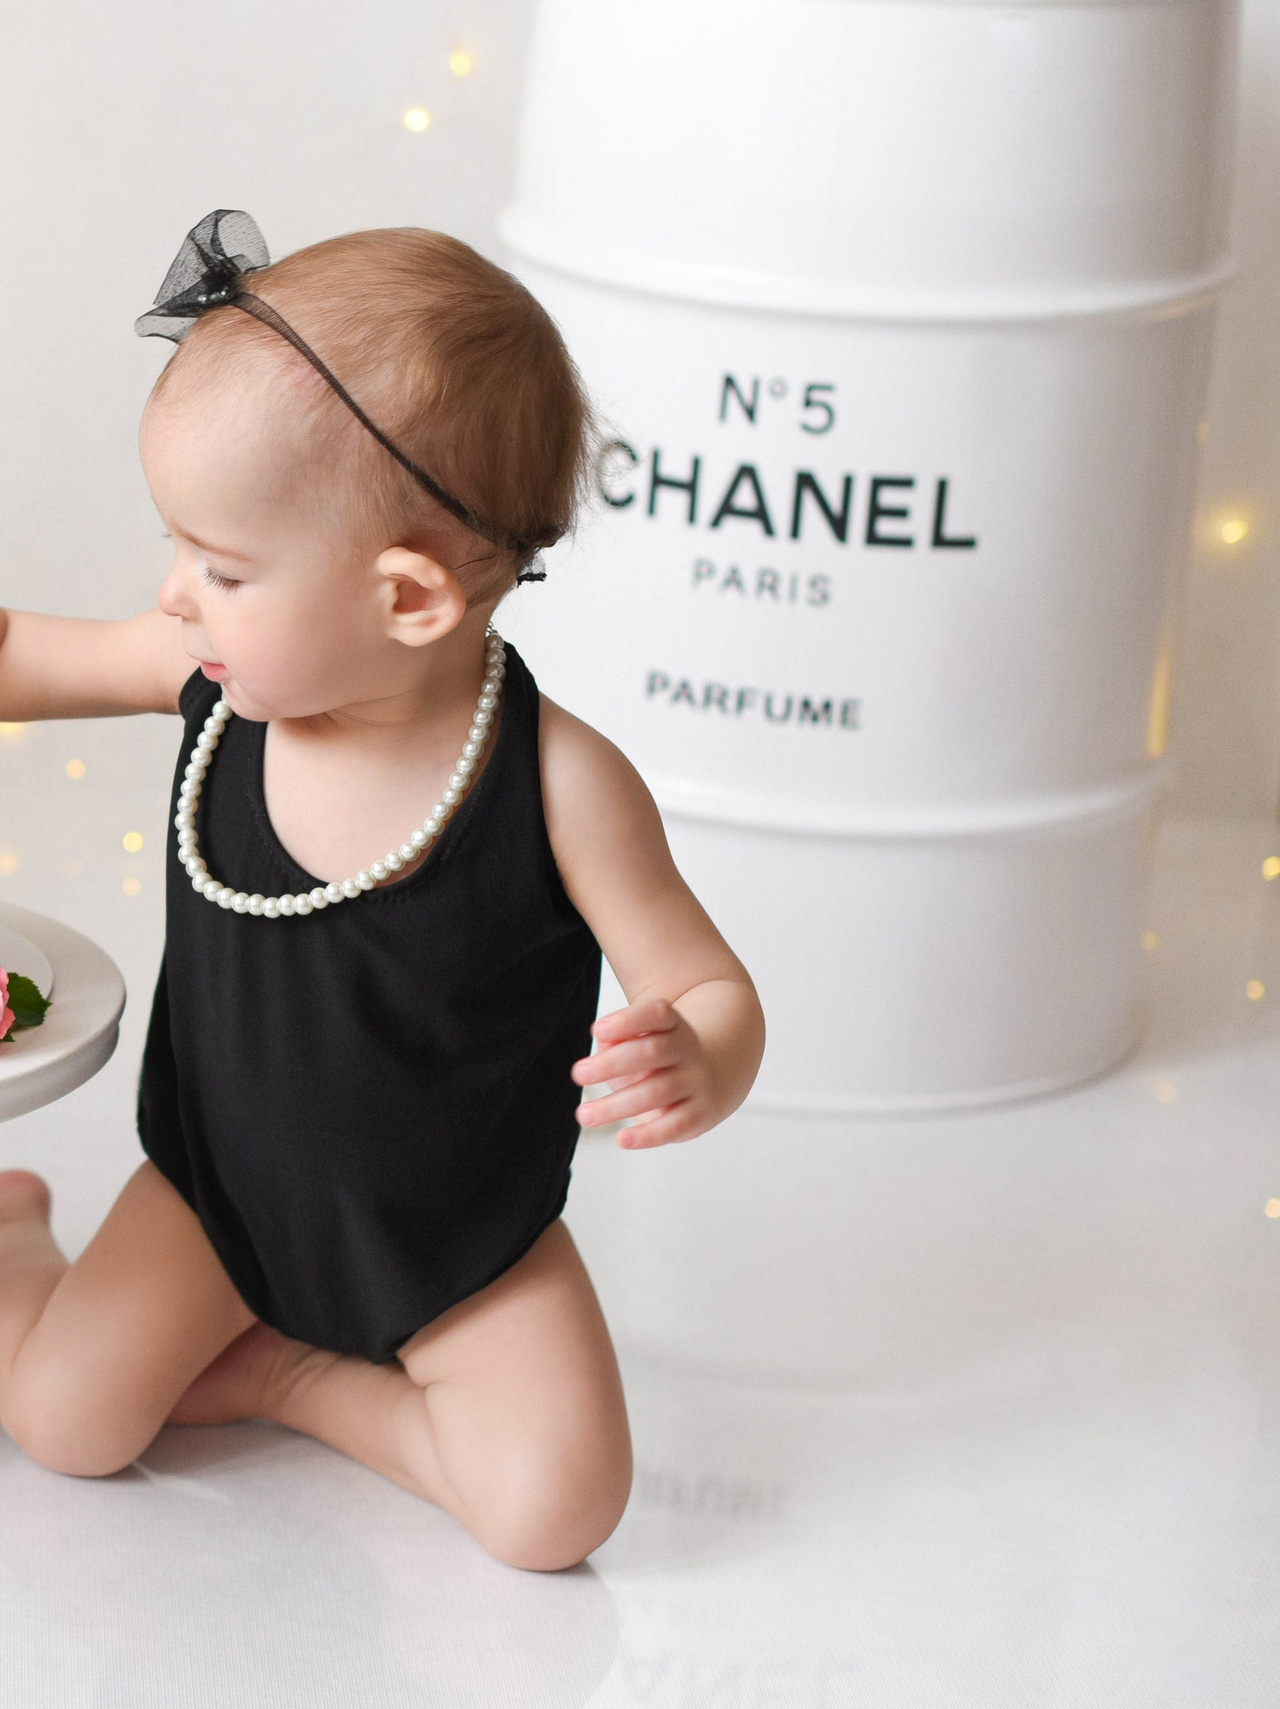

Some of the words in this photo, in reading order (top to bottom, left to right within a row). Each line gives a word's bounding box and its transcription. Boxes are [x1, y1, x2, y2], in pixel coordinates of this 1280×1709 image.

[800, 383, 836, 435] 5
[596, 438, 977, 549] CHANEL
[692, 558, 833, 607] PARIS
[646, 670, 862, 730] PARFUME
